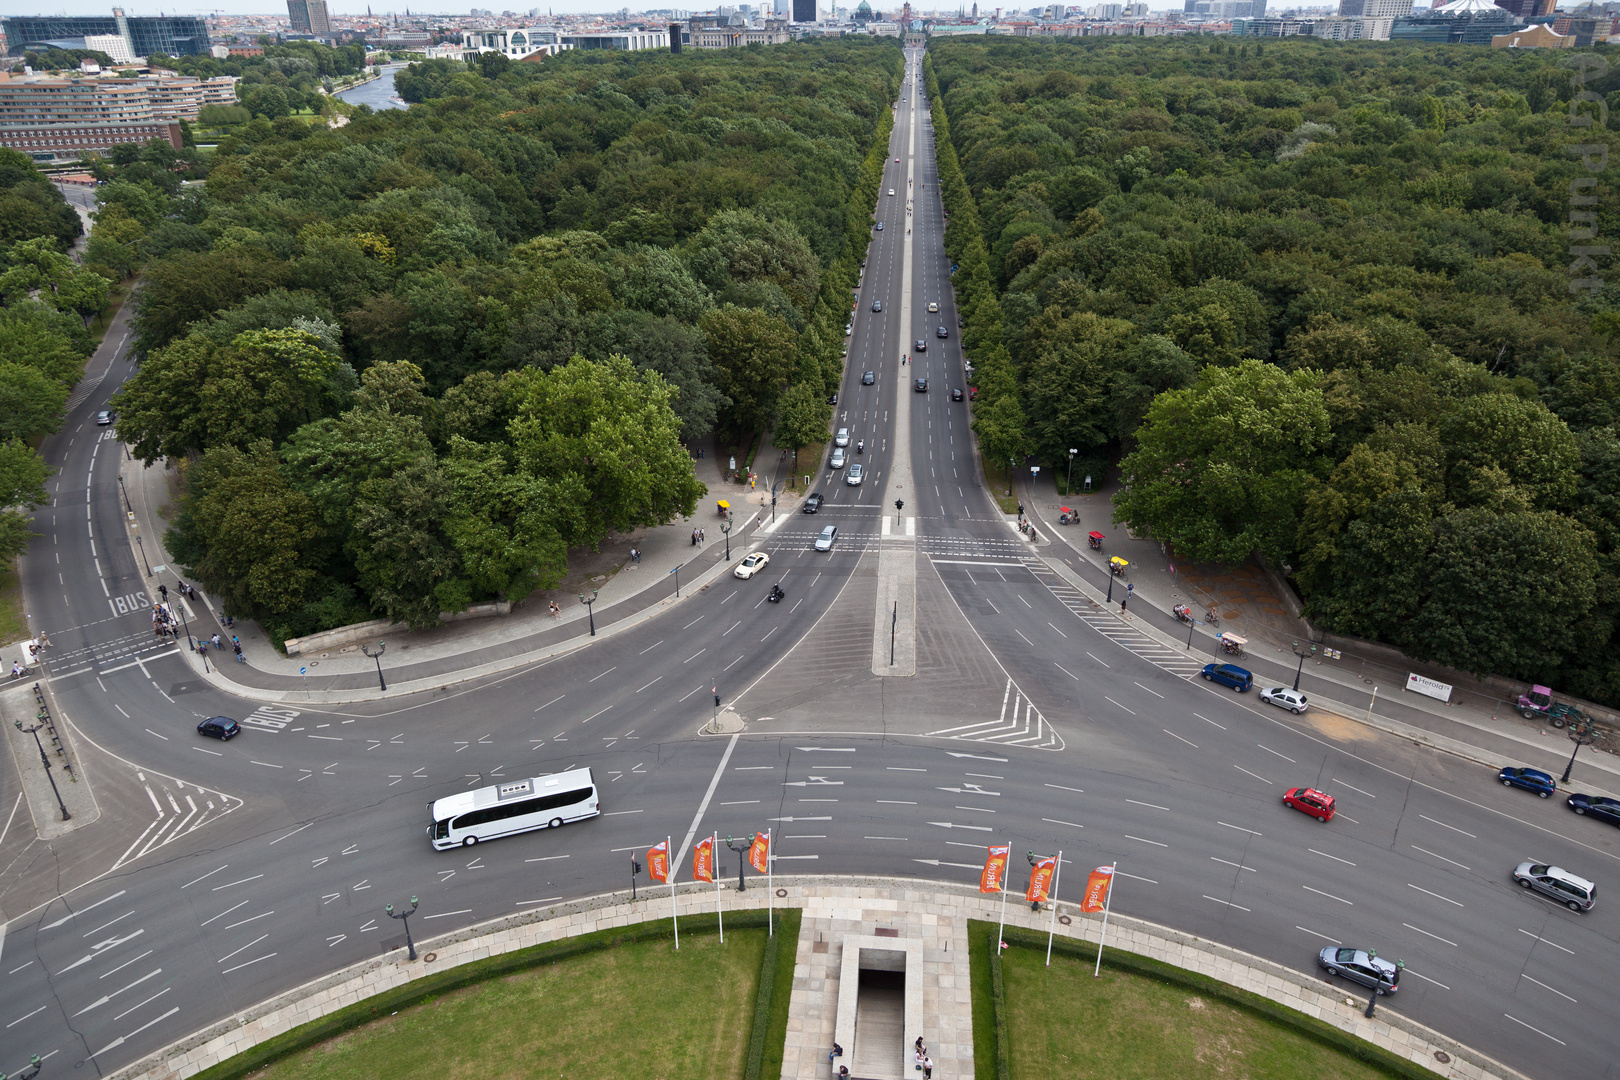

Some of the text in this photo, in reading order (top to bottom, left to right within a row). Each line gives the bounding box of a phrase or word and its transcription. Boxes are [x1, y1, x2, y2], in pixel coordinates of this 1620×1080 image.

[115, 591, 150, 614] BUS
[1418, 676, 1444, 690] Herold
[243, 705, 301, 729] BUS
